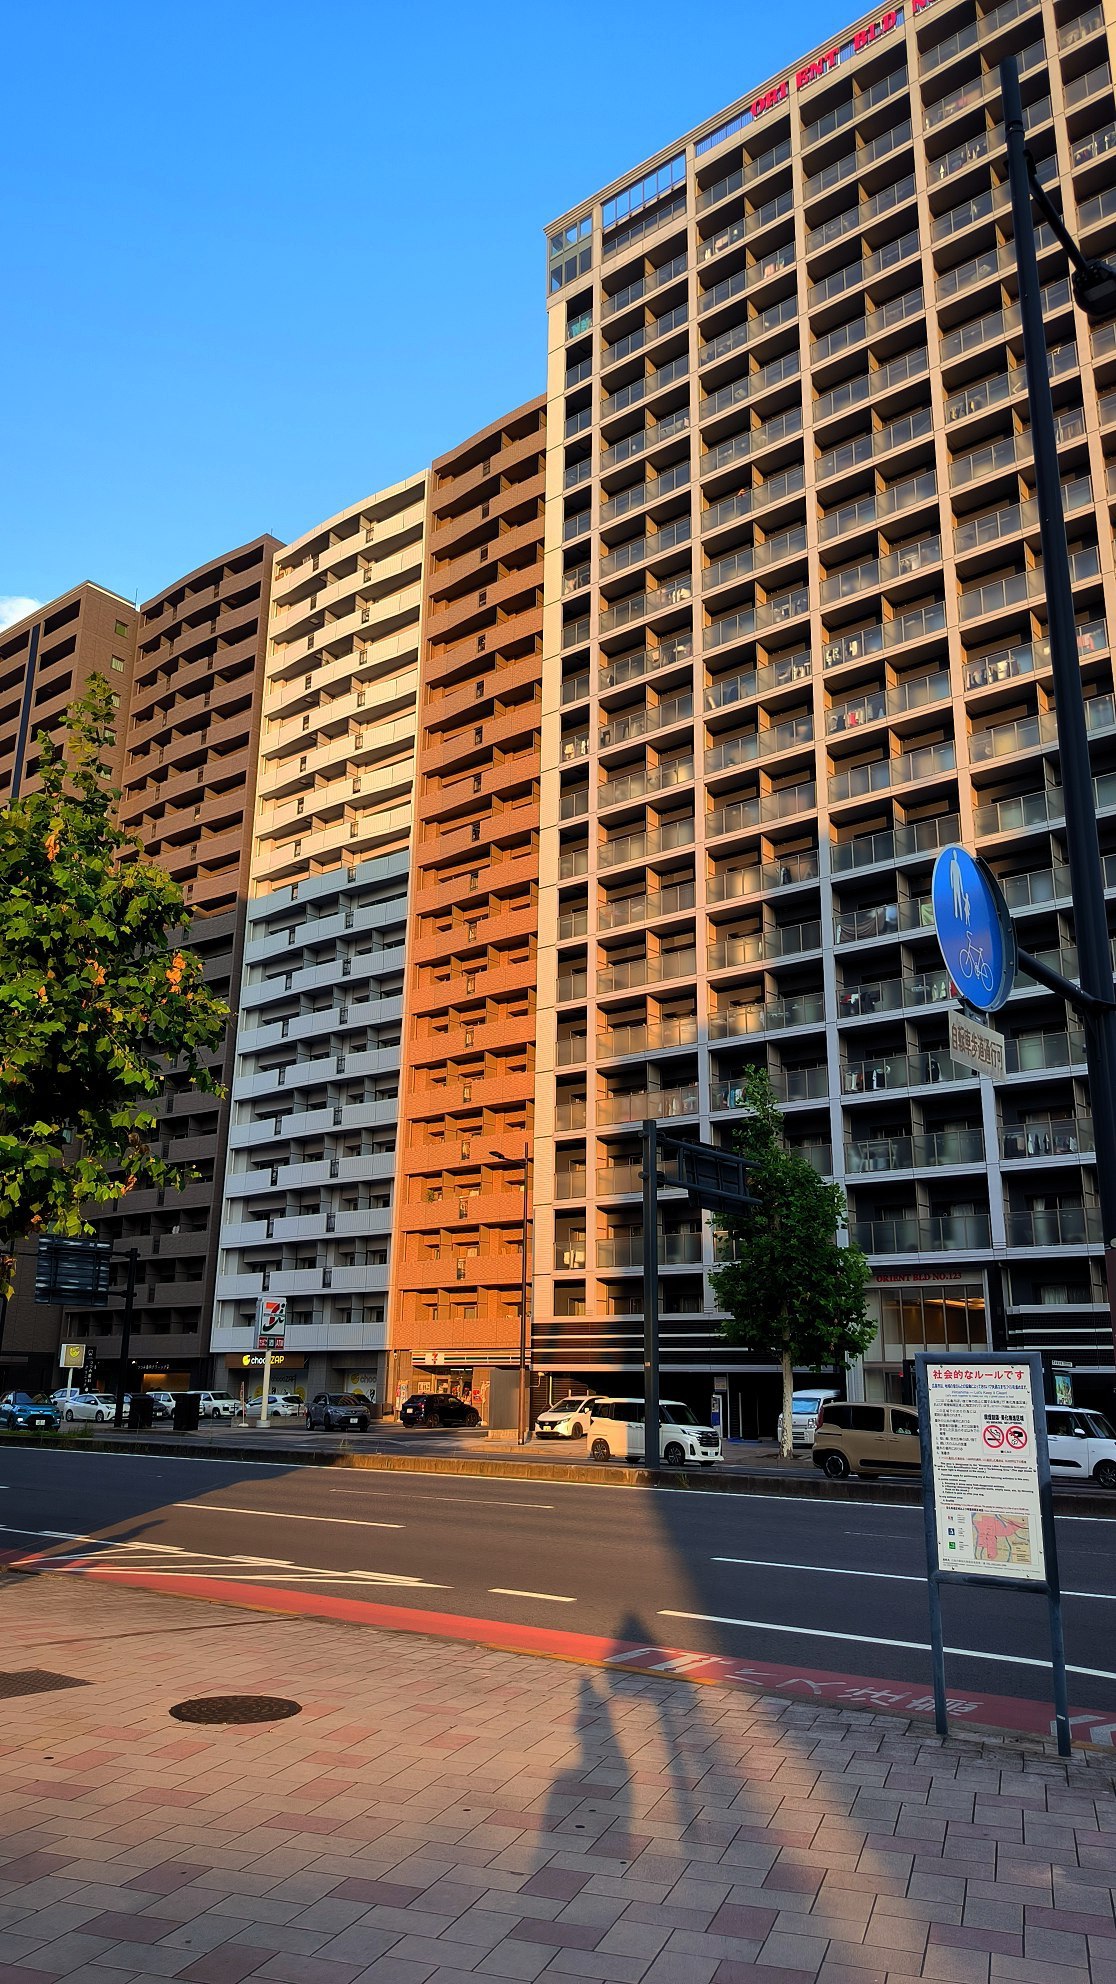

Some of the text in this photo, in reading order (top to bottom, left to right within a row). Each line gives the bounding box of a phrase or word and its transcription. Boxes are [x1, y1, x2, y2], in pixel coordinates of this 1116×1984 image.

[875, 1273, 911, 1283] ORIENT
[912, 1272, 931, 1282] BLD
[250, 1355, 285, 1365] chocZAP
[932, 1369, 1025, 1381] 社会的なルールです
